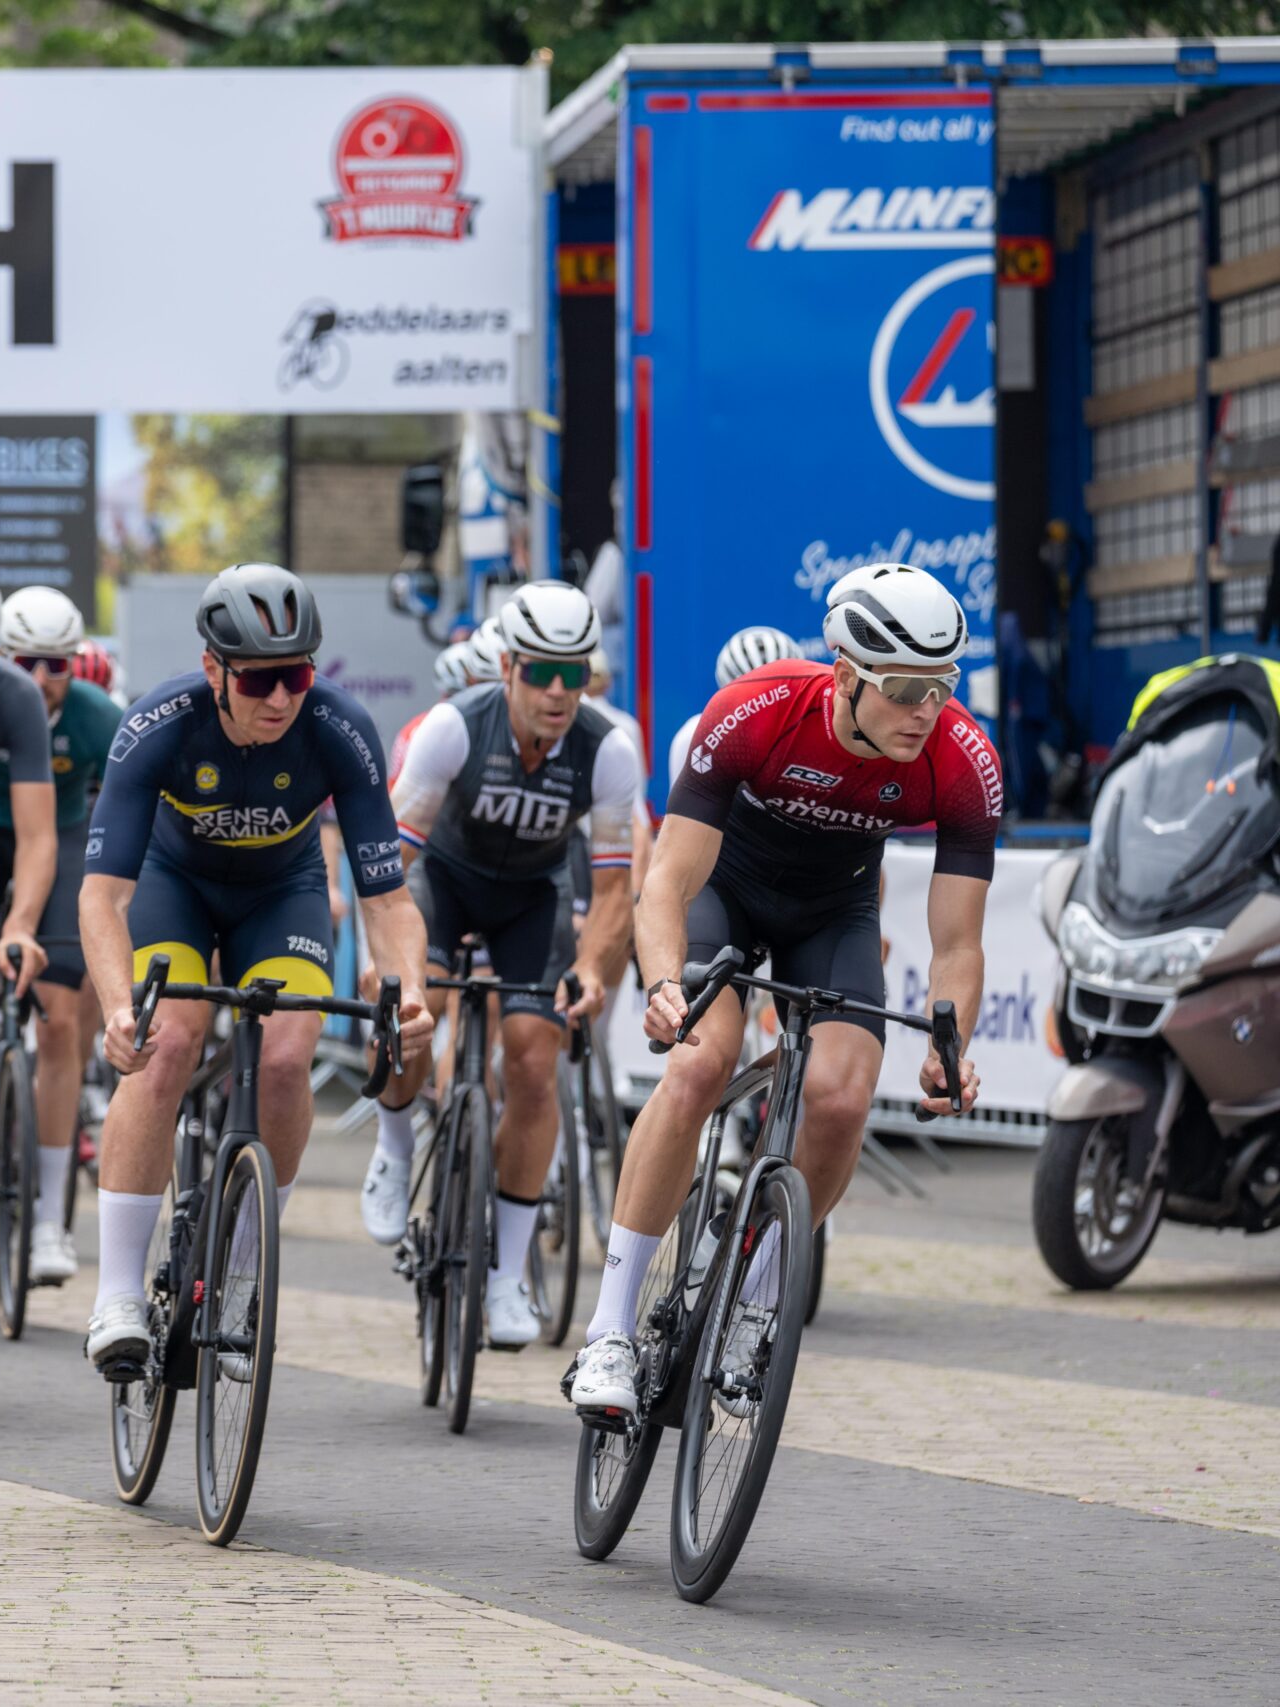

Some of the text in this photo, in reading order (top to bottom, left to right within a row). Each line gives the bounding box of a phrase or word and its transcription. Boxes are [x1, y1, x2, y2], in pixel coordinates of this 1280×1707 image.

[841, 115, 897, 142] Find
[899, 117, 941, 142] out
[944, 115, 974, 142] all
[395, 354, 508, 384] aalten
[127, 692, 192, 733] Evers
[704, 684, 791, 750] BROEKHUIS
[471, 784, 570, 831] MTH
